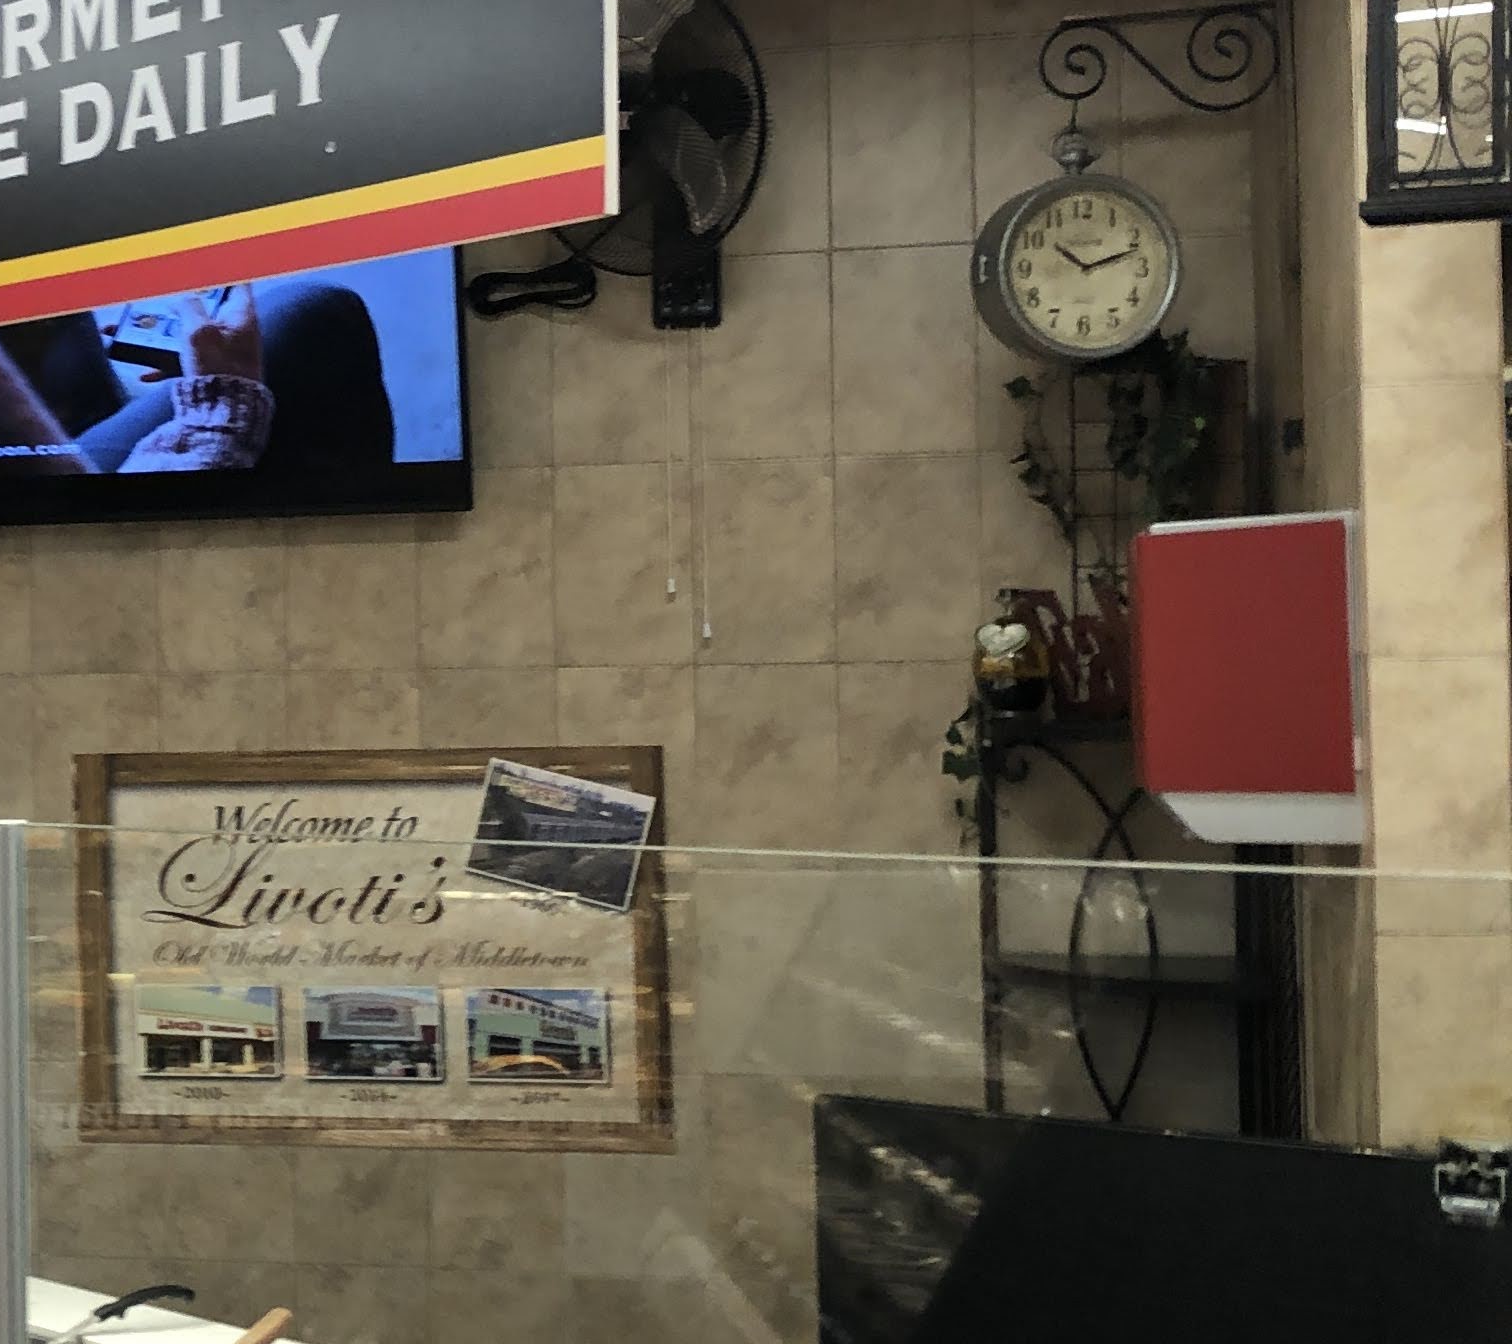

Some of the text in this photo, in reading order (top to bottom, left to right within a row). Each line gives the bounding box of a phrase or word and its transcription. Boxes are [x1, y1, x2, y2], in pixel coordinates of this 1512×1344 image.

[58, 13, 341, 167] DAILY
[1023, 230, 1045, 250] 10
[214, 799, 420, 846] Welcome to
[140, 832, 449, 930] Livoti's
